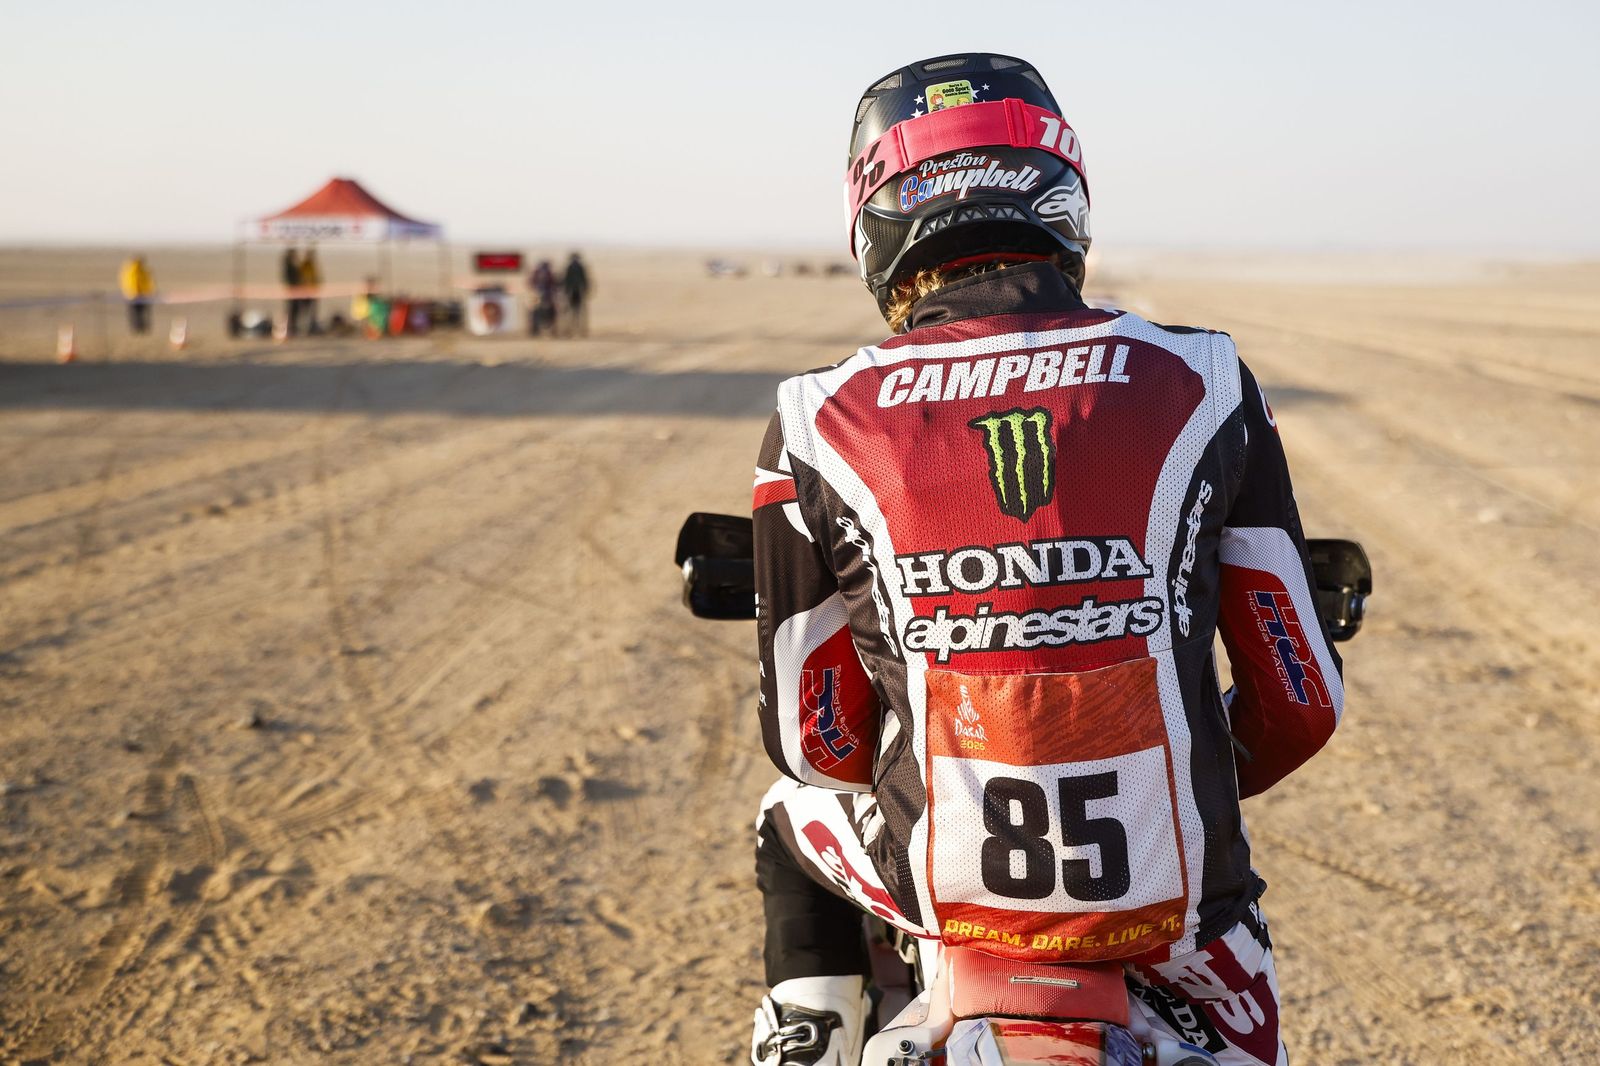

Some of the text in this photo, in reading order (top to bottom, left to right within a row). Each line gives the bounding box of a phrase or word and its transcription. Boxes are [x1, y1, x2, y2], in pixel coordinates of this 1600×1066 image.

[900, 160, 1041, 211] Campbell
[919, 152, 988, 178] Preston
[877, 344, 1131, 408] CAMPBELL
[897, 538, 1151, 594] HONDA
[1170, 479, 1213, 638] alpinestars
[904, 598, 1163, 662] alpinestars
[1267, 644, 1297, 703] RACING
[981, 770, 1131, 902] 85
[944, 919, 1026, 948] DREAM.
[1031, 934, 1101, 951] DARE.
[1106, 923, 1153, 947] LIVE
